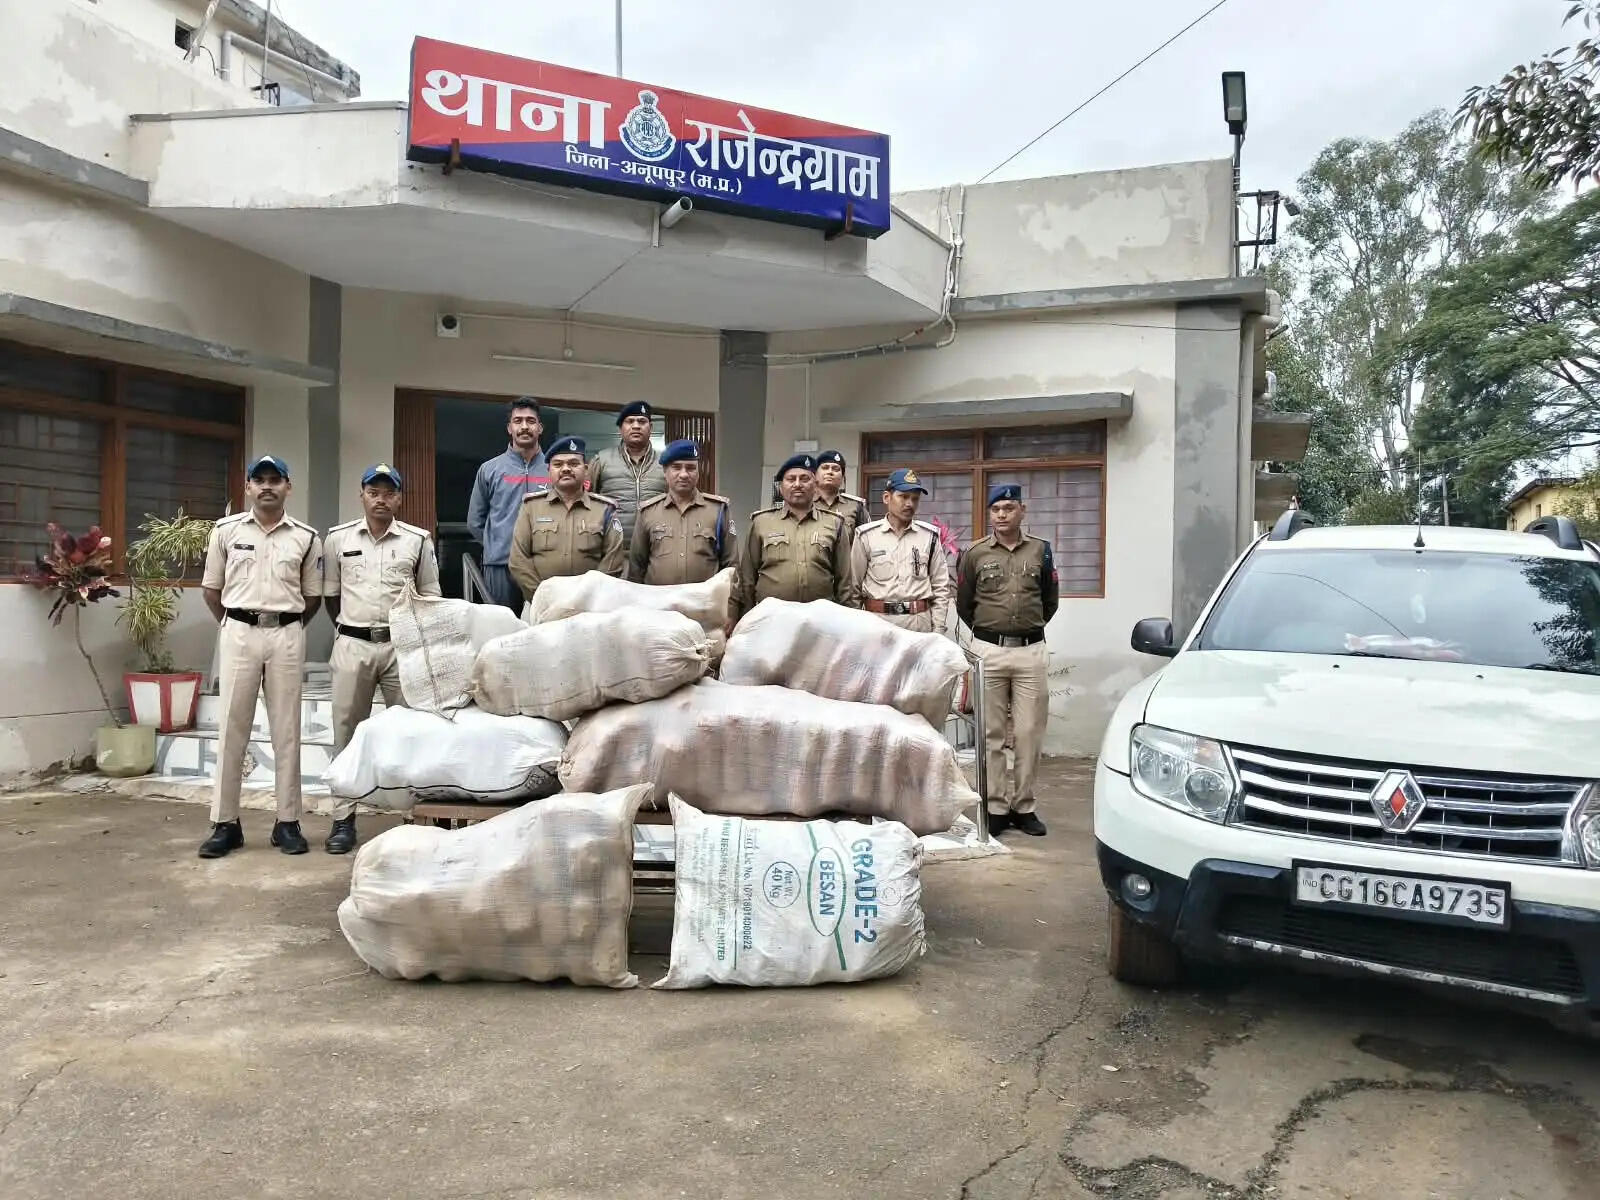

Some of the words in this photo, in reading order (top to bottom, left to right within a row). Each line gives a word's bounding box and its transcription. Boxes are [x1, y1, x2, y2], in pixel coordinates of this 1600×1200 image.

[421, 68, 612, 149] थाना
[684, 109, 881, 200] राजेन्द्रग्राम
[690, 169, 742, 195] (म.प्र.)
[743, 864, 754, 881] No.
[771, 866, 783, 881] 40
[819, 860, 835, 916] BESAN
[1302, 879, 1318, 888] IND
[850, 838, 878, 944] GRADE-2
[1319, 873, 1504, 919] CG16CA9735
[717, 927, 726, 961] LIMITED
